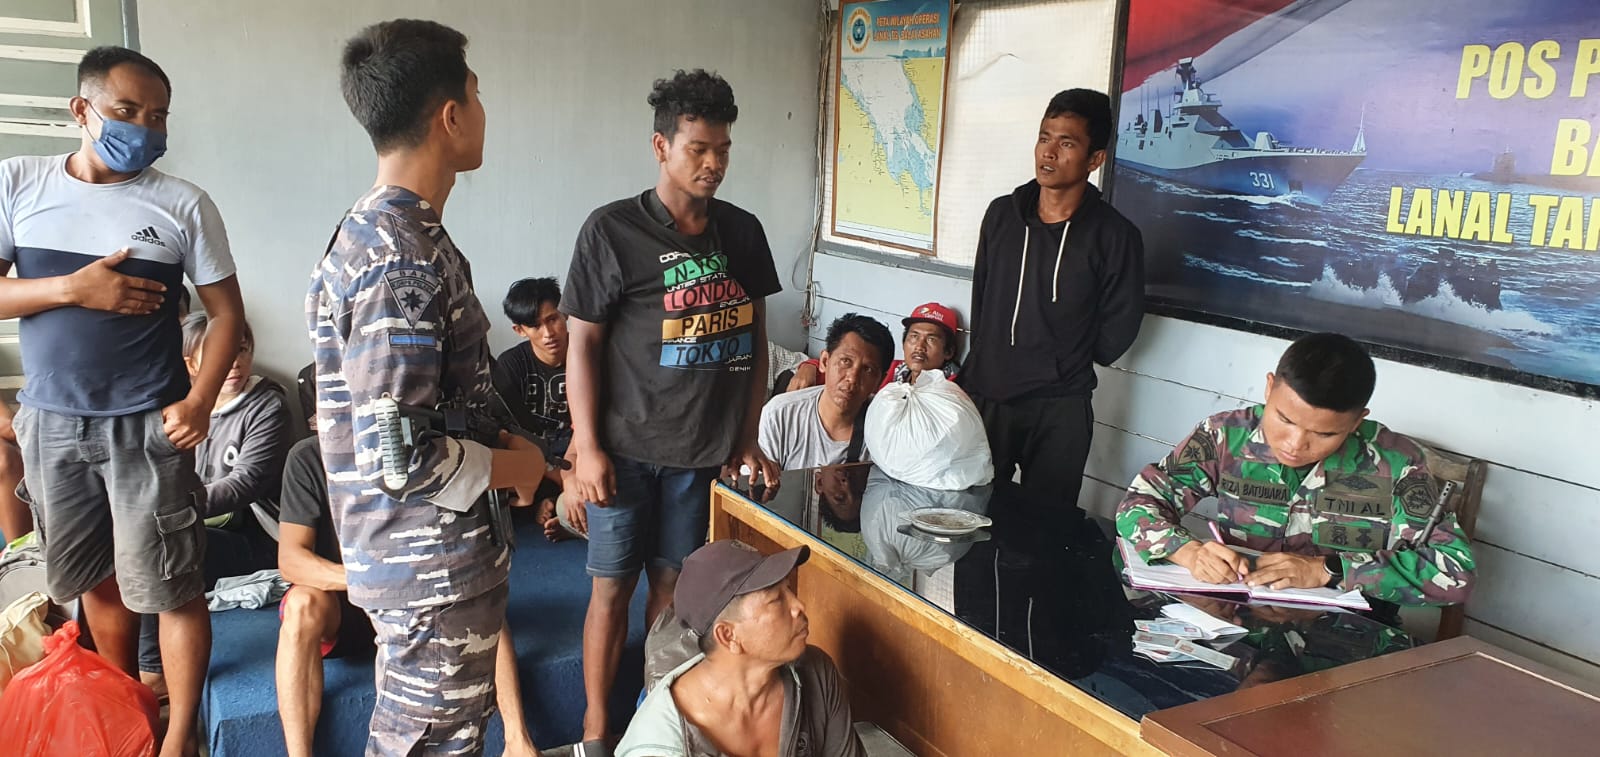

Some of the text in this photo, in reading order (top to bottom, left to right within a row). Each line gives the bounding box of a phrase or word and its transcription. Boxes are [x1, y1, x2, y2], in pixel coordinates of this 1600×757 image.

[1455, 39, 1561, 99] POS
[1249, 171, 1275, 189] 331
[1386, 186, 1514, 245] LANAL
[131, 235, 166, 247] adidas
[682, 308, 739, 335] PARIS
[676, 337, 739, 364] TOKYO
[1324, 497, 1386, 516] TNI AL
